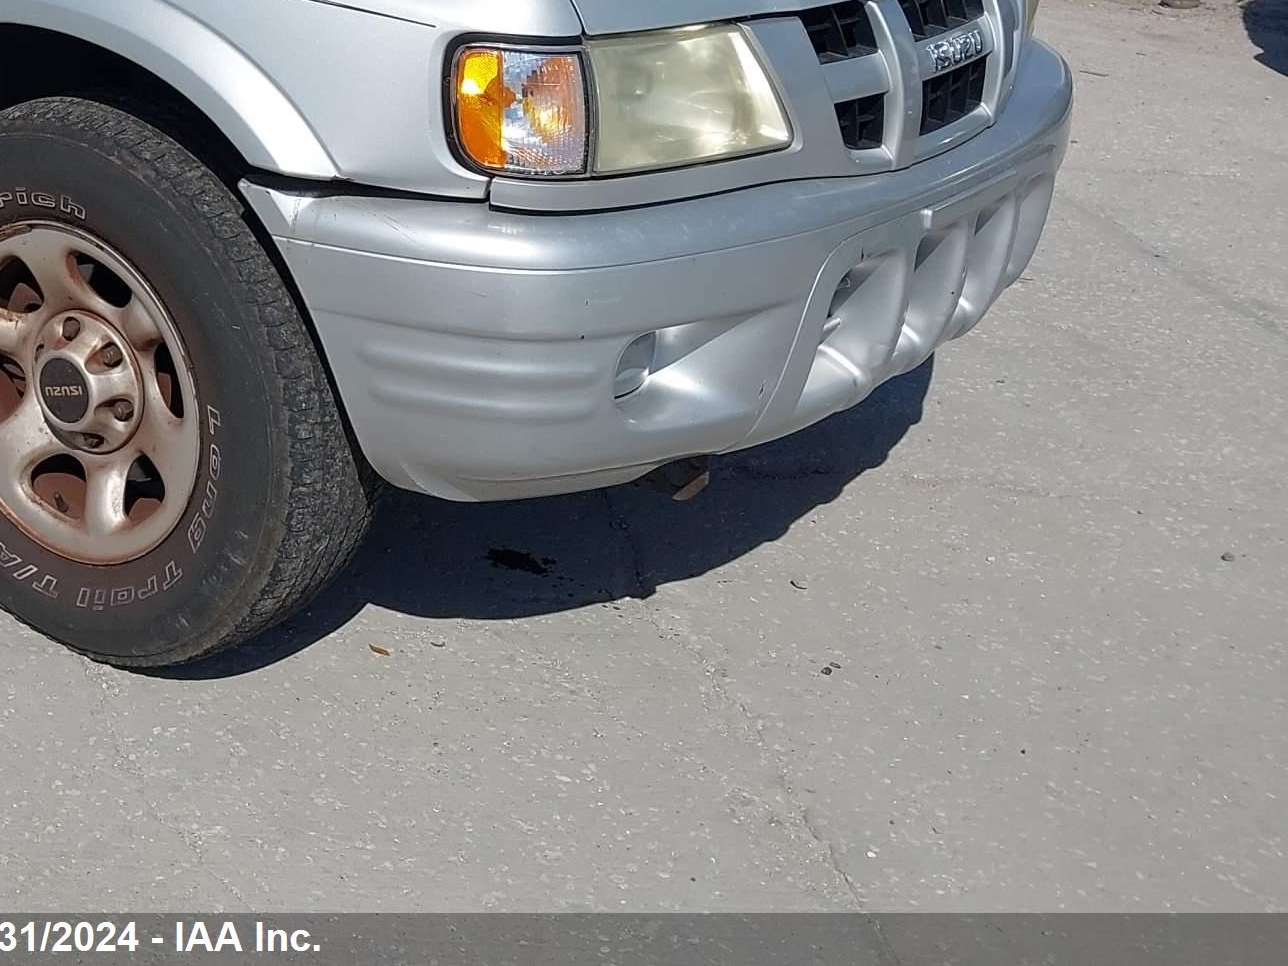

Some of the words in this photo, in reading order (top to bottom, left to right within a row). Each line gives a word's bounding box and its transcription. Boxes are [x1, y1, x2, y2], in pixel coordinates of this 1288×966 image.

[925, 29, 983, 73] ISUZU
[44, 385, 84, 397] ISUZU
[187, 404, 222, 554] Long
[75, 561, 184, 611] Trail
